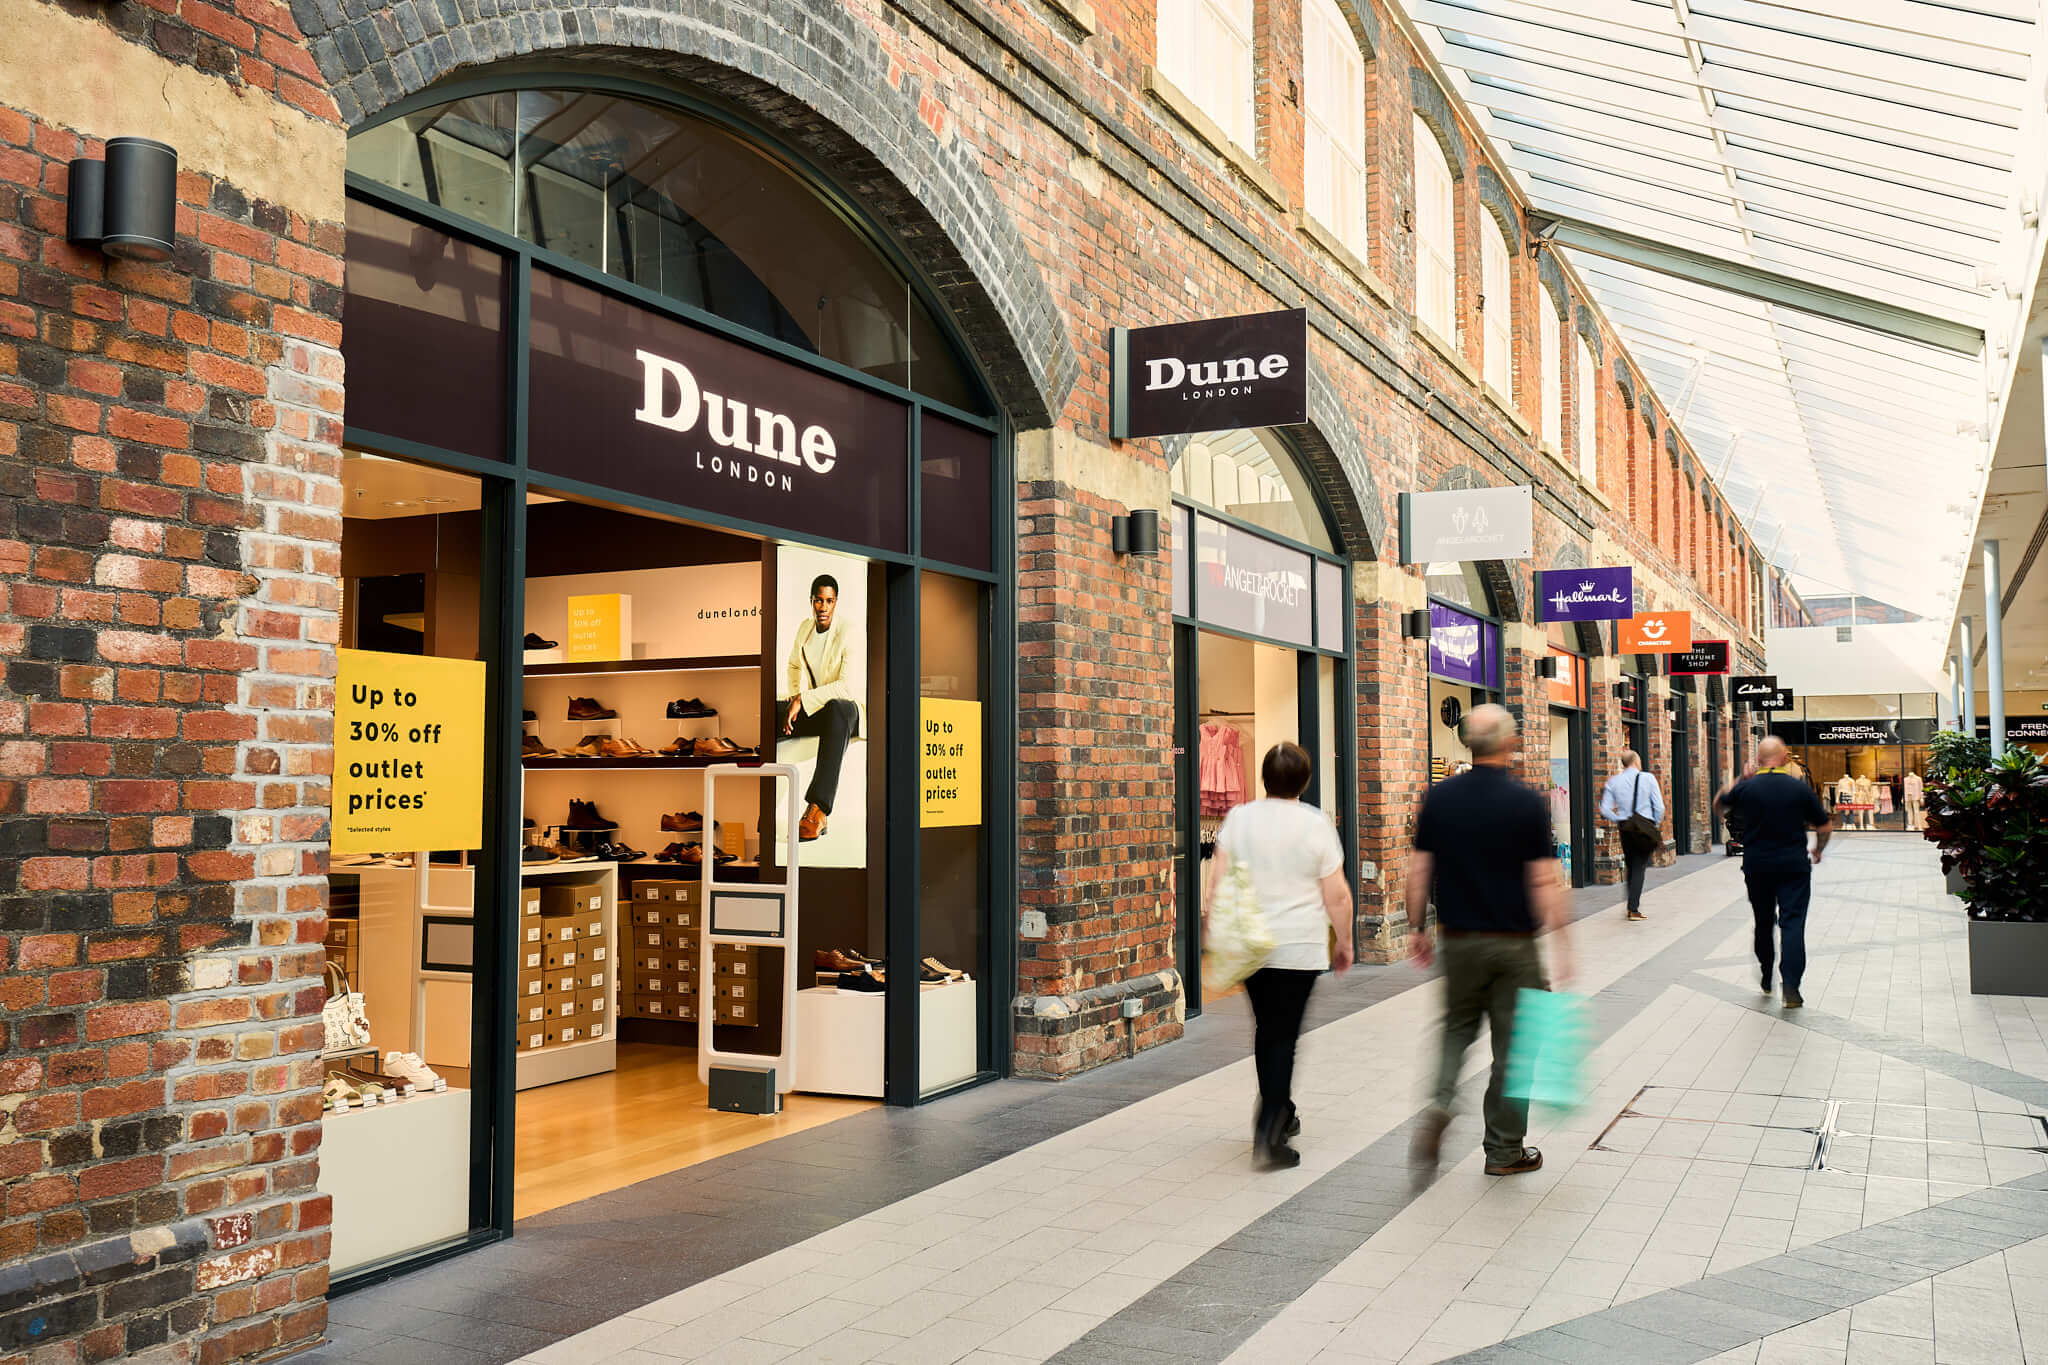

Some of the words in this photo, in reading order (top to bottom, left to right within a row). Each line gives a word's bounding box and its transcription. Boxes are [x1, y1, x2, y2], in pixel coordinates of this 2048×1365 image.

[1145, 354, 1289, 391] Dune
[1182, 386, 1252, 401] LONDON
[635, 348, 837, 474] Dune
[696, 451, 792, 492] LONDON
[1548, 587, 1627, 612] Hallmark
[352, 684, 383, 709] Up
[393, 688, 417, 707] to
[350, 721, 399, 742] 30%
[408, 724, 442, 743] off
[926, 720, 939, 736] Up
[943, 721, 953, 733] to
[1819, 732, 1888, 740] CONNECTION
[925, 743, 946, 757] 30%
[949, 743, 964, 757] off
[349, 758, 424, 779] outlet
[926, 766, 957, 780] outlet
